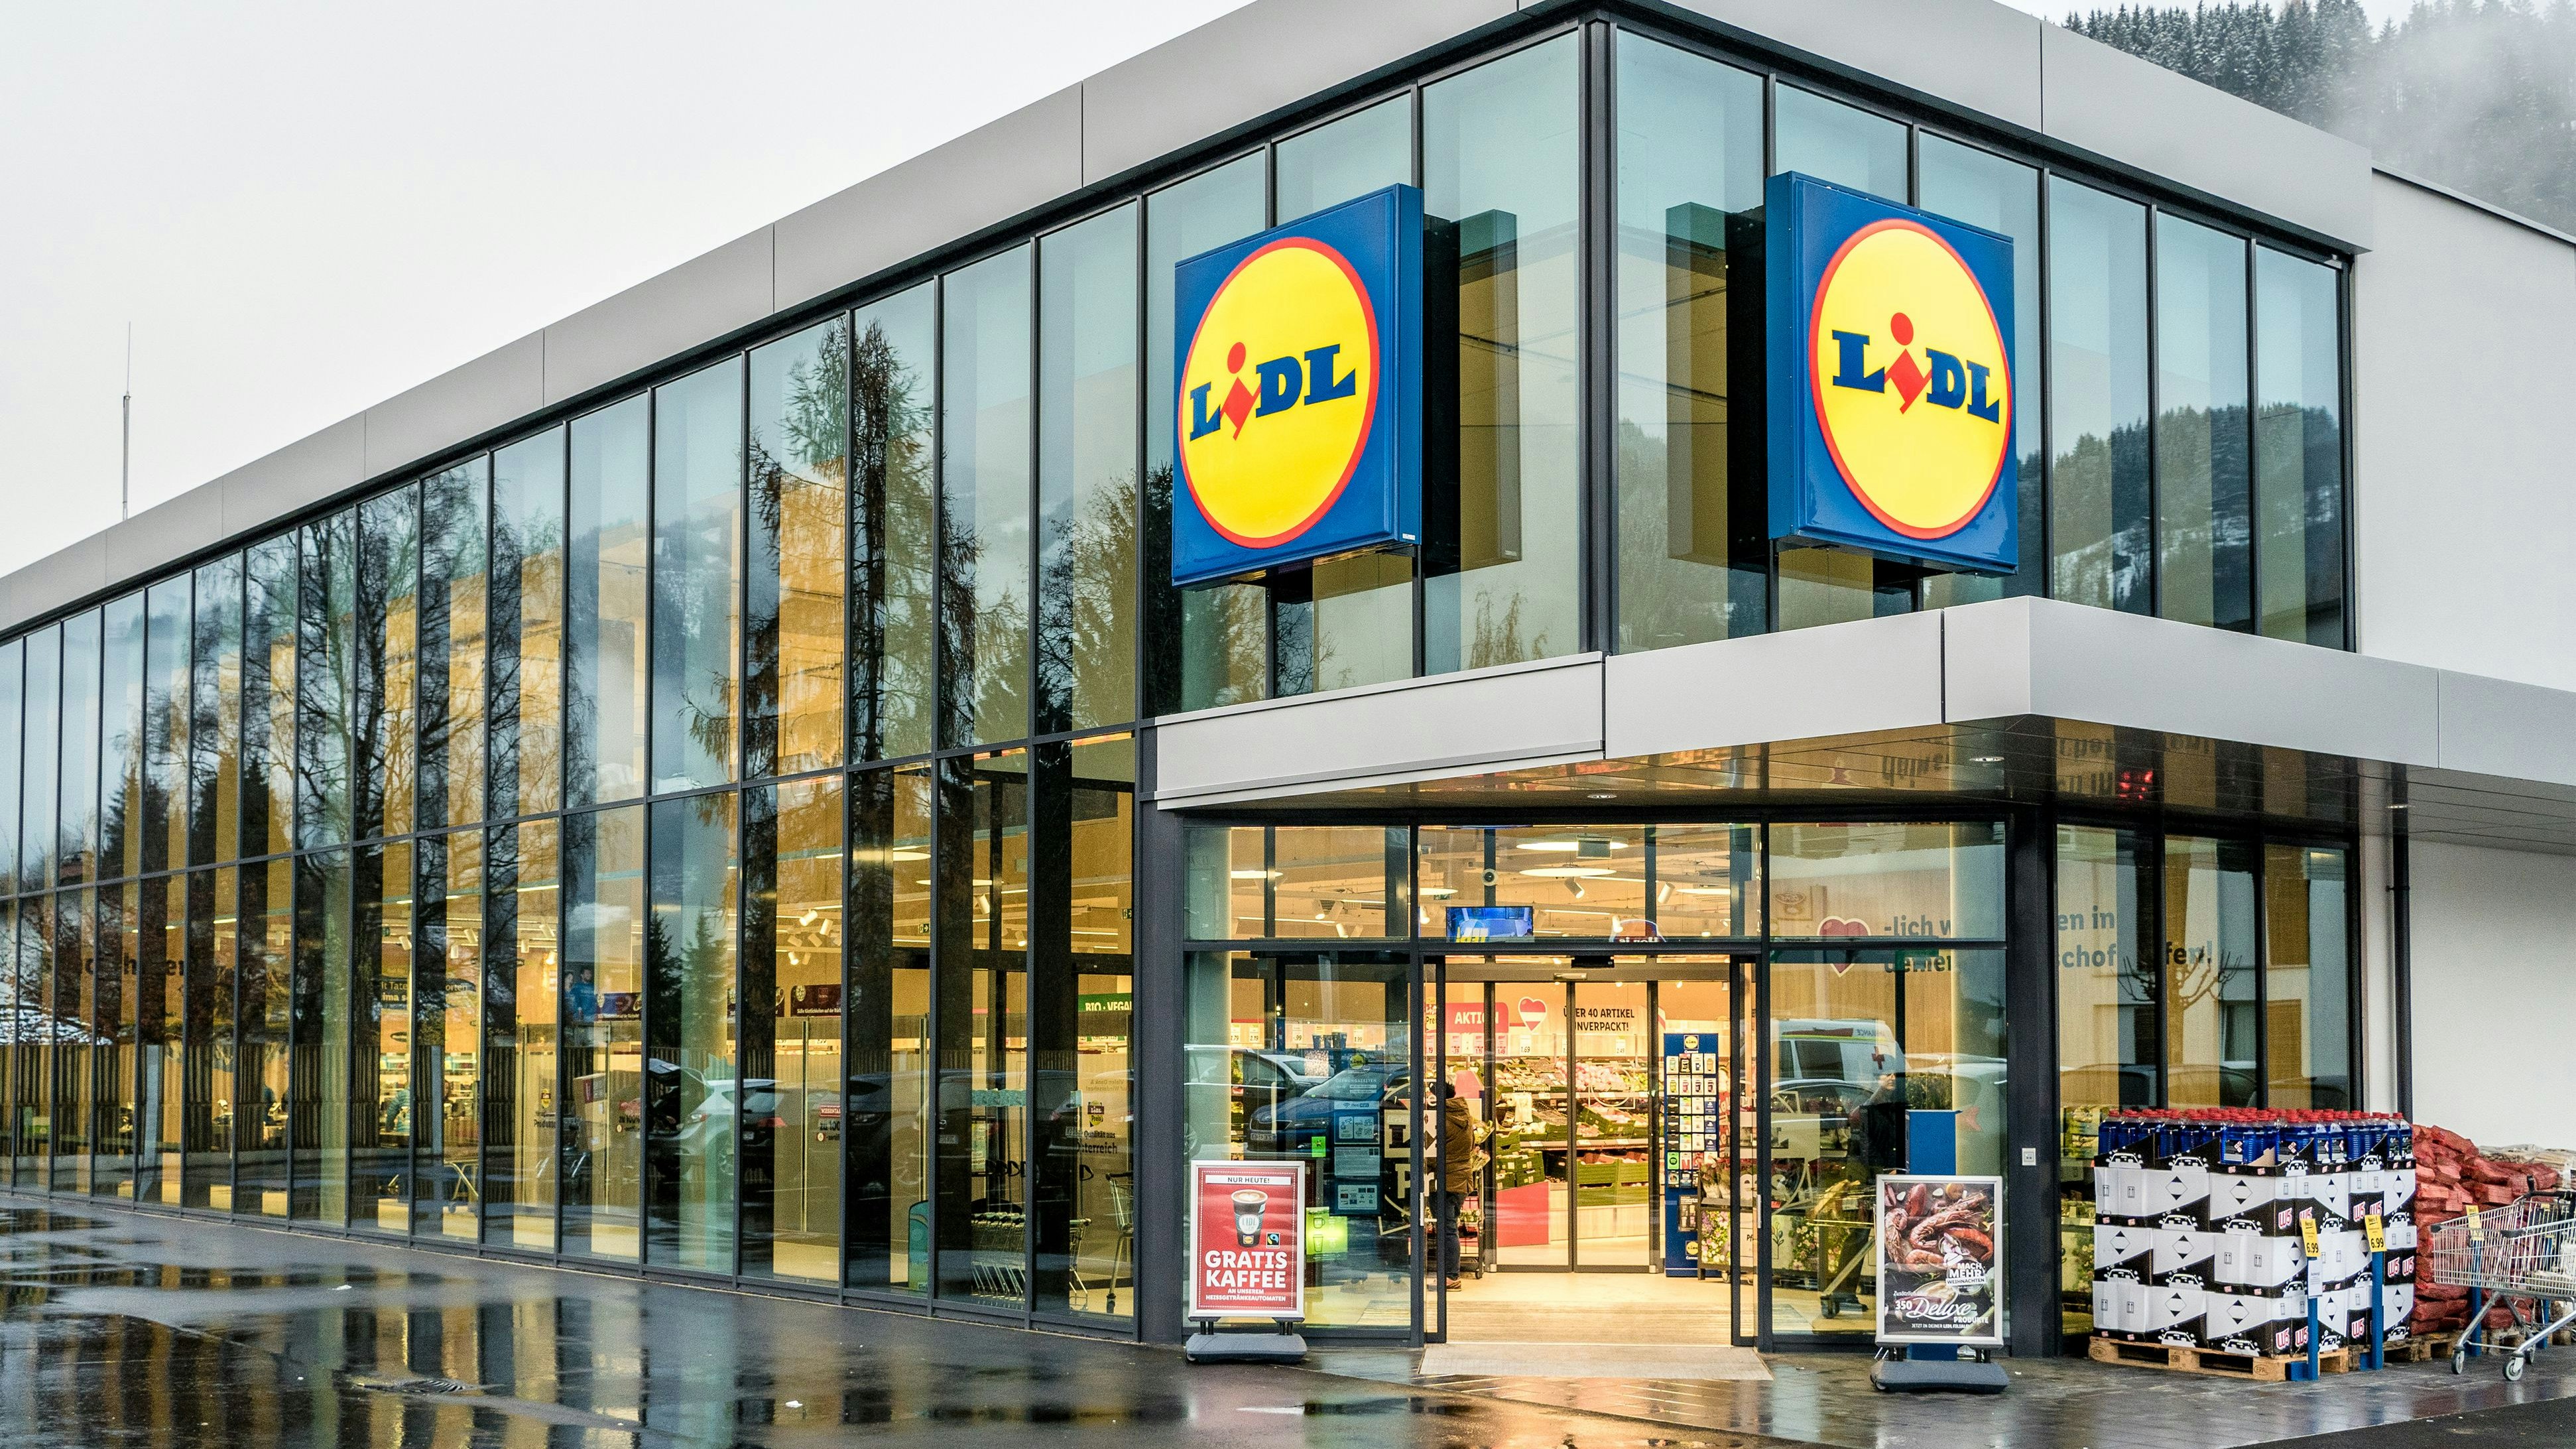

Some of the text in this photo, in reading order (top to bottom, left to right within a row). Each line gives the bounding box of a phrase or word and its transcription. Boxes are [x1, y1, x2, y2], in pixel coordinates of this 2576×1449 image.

[1831, 312, 2000, 424] LIDL
[1190, 342, 1357, 442] LIDL
[2092, 906, 2115, 930] in
[390, 981, 407, 990] Tate
[382, 992, 399, 1001] ima
[1107, 1001, 1132, 1011] VEGA
[1588, 1009, 1598, 1017] 40
[1600, 1009, 1634, 1018] ARTIKEL
[1575, 1021, 1628, 1031] NVERPACKT!
[1084, 1130, 1105, 1139] Qualität
[2278, 1208, 2293, 1229] W5
[2353, 1201, 2366, 1222] W5
[2306, 1242, 2319, 1253] 6.99
[2370, 1237, 2384, 1248] 6.99
[1205, 1250, 1287, 1269] GRATIS
[2388, 1257, 2400, 1278] W5
[2402, 1256, 2415, 1277] W5
[1205, 1270, 1286, 1289] KAFFEE
[1949, 1269, 1982, 1278] MEHR
[1895, 1297, 1971, 1320] 350 Deluxe
[2351, 1317, 2365, 1339] W5
[2275, 1327, 2290, 1350] W5
